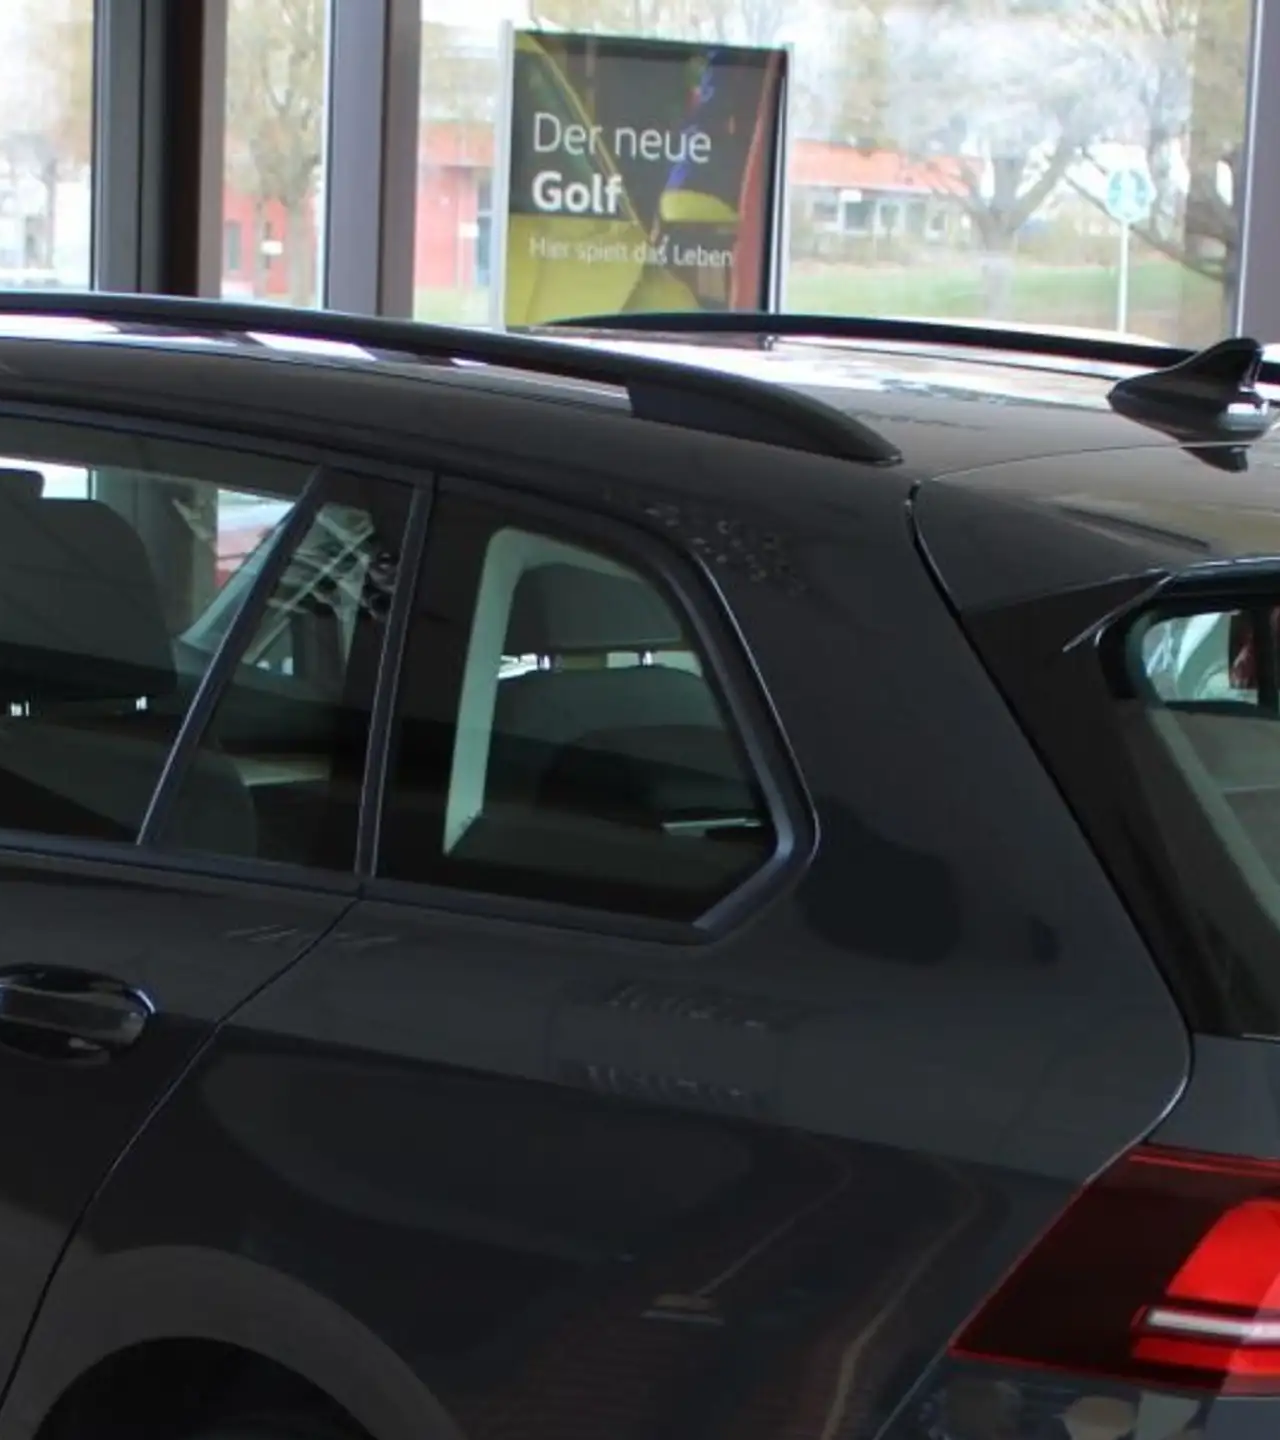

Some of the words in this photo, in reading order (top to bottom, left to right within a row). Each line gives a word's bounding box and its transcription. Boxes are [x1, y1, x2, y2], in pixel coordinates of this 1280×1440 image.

[533, 112, 603, 155] Der
[615, 124, 712, 163] neue
[531, 170, 623, 214] Golf
[673, 243, 734, 268] Leben
